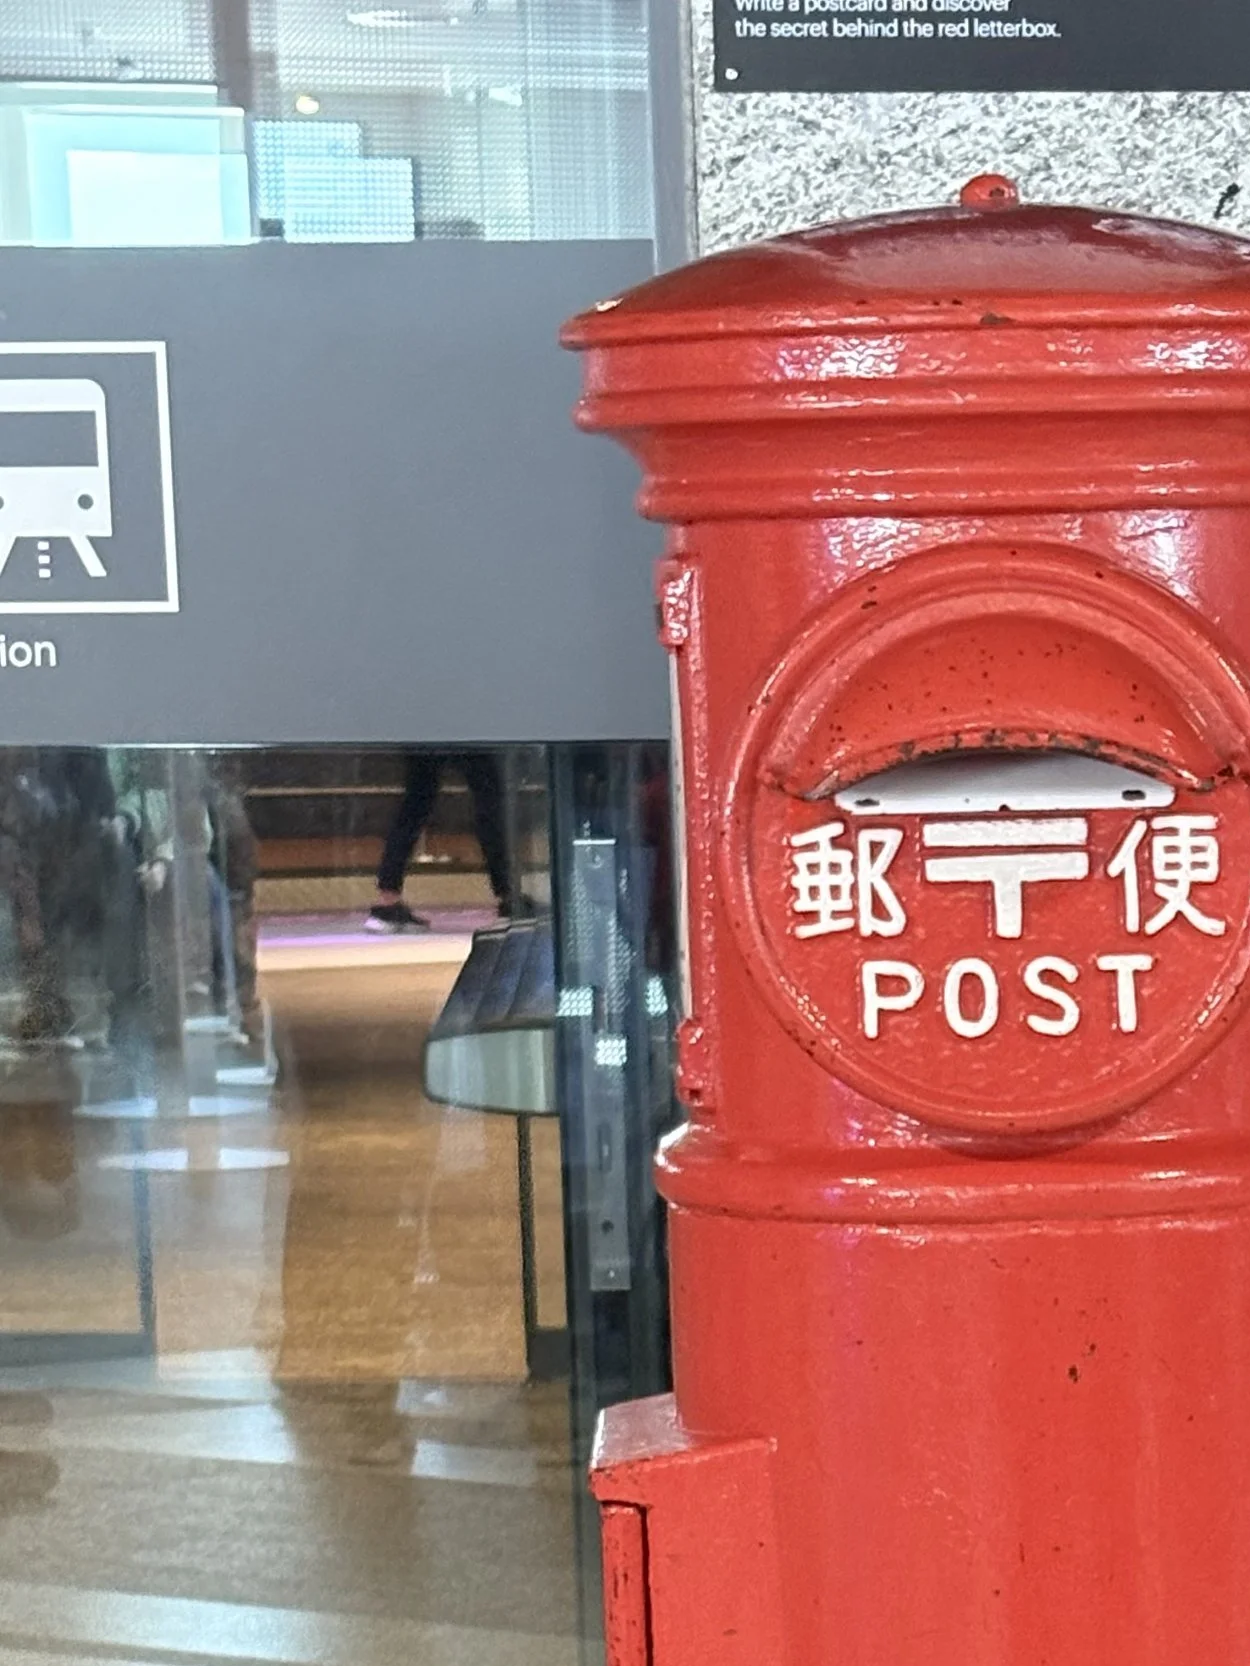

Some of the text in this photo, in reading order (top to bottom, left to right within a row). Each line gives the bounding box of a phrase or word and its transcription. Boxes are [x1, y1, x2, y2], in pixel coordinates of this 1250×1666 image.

[736, 0, 1012, 15] Write a postcard and discover
[735, 18, 1062, 37] the secret behind the red letterbox.
[861, 954, 1155, 1039] POST
